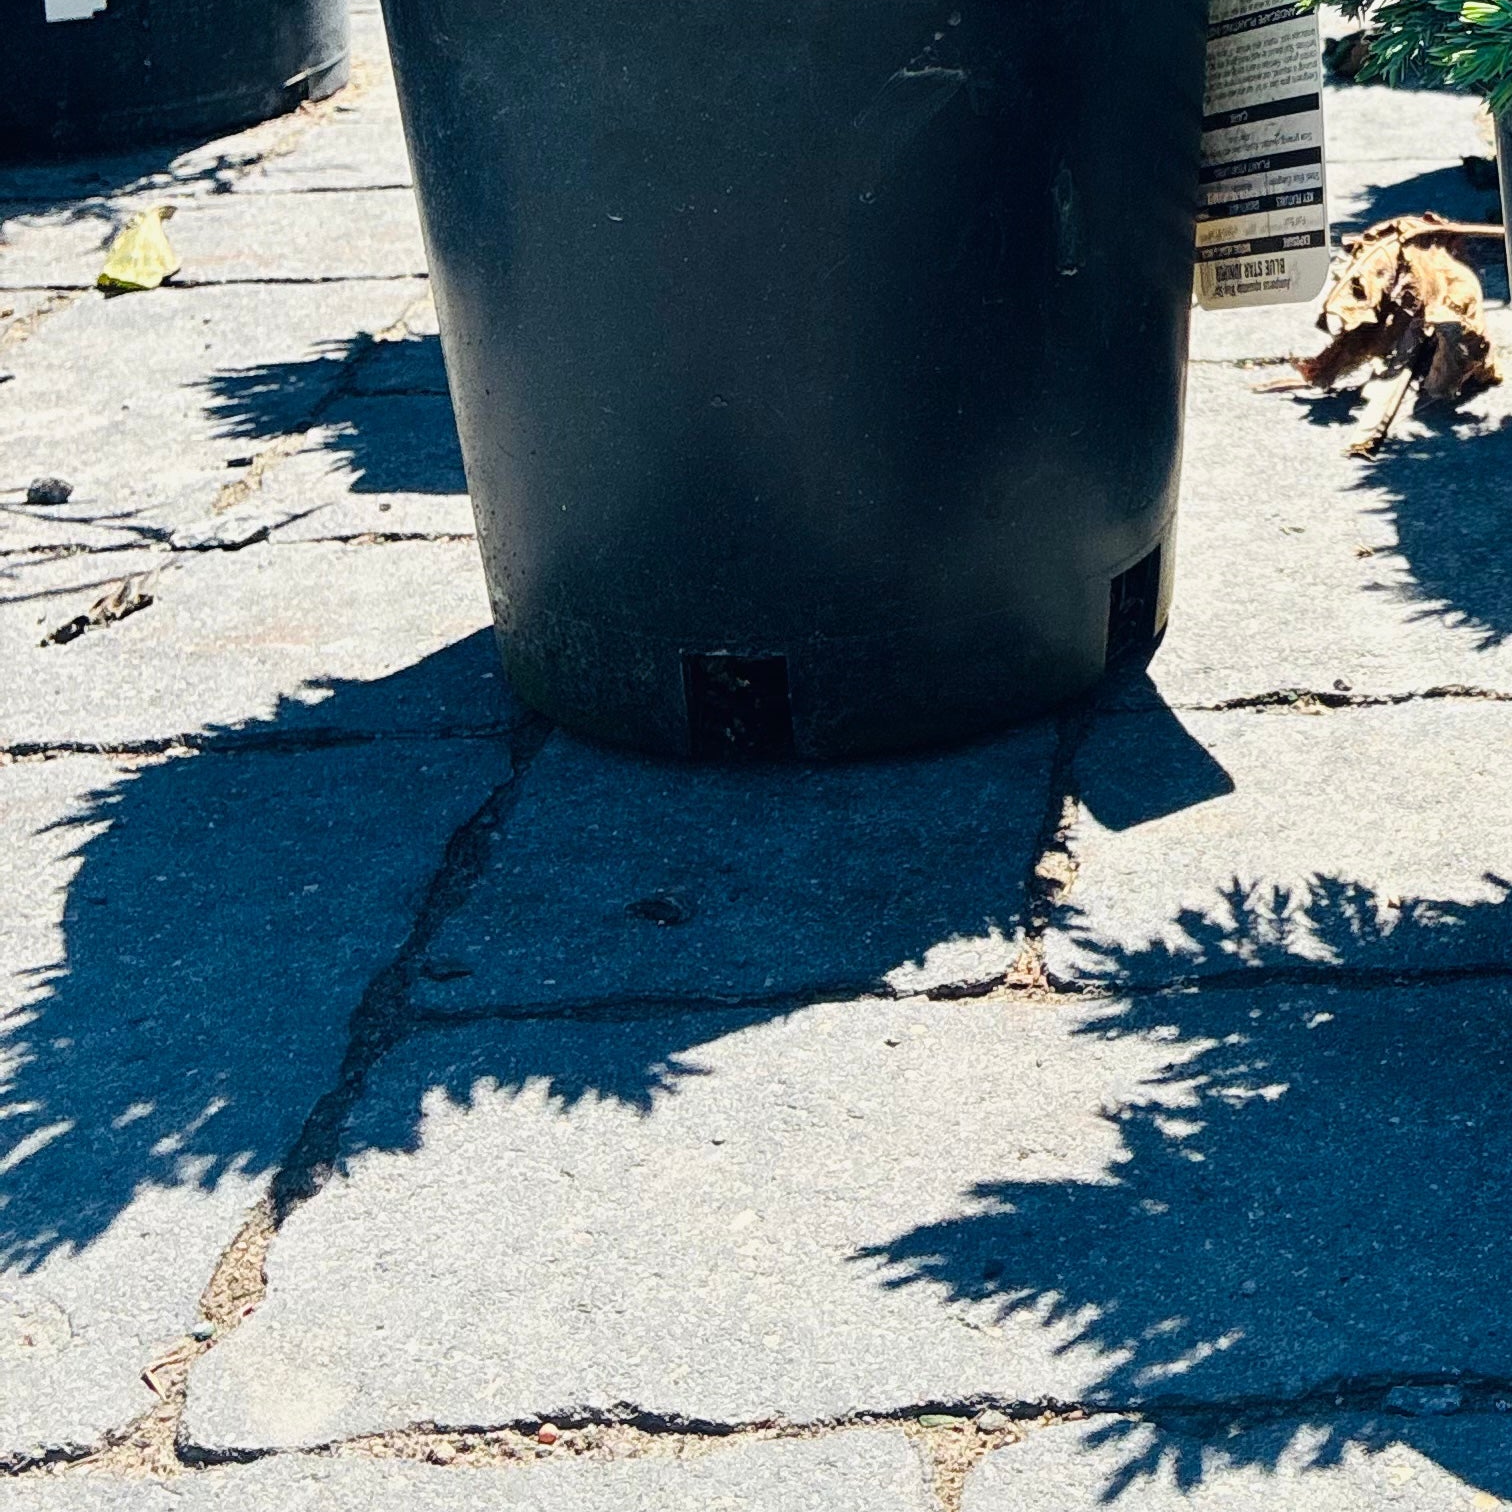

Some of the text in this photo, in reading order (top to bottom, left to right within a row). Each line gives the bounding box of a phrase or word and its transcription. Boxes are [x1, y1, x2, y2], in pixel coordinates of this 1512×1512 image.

[1258, 7, 1296, 25] ANDSCAPE
[1243, 261, 1263, 279] STAR
[1265, 258, 1286, 276] BLUE
